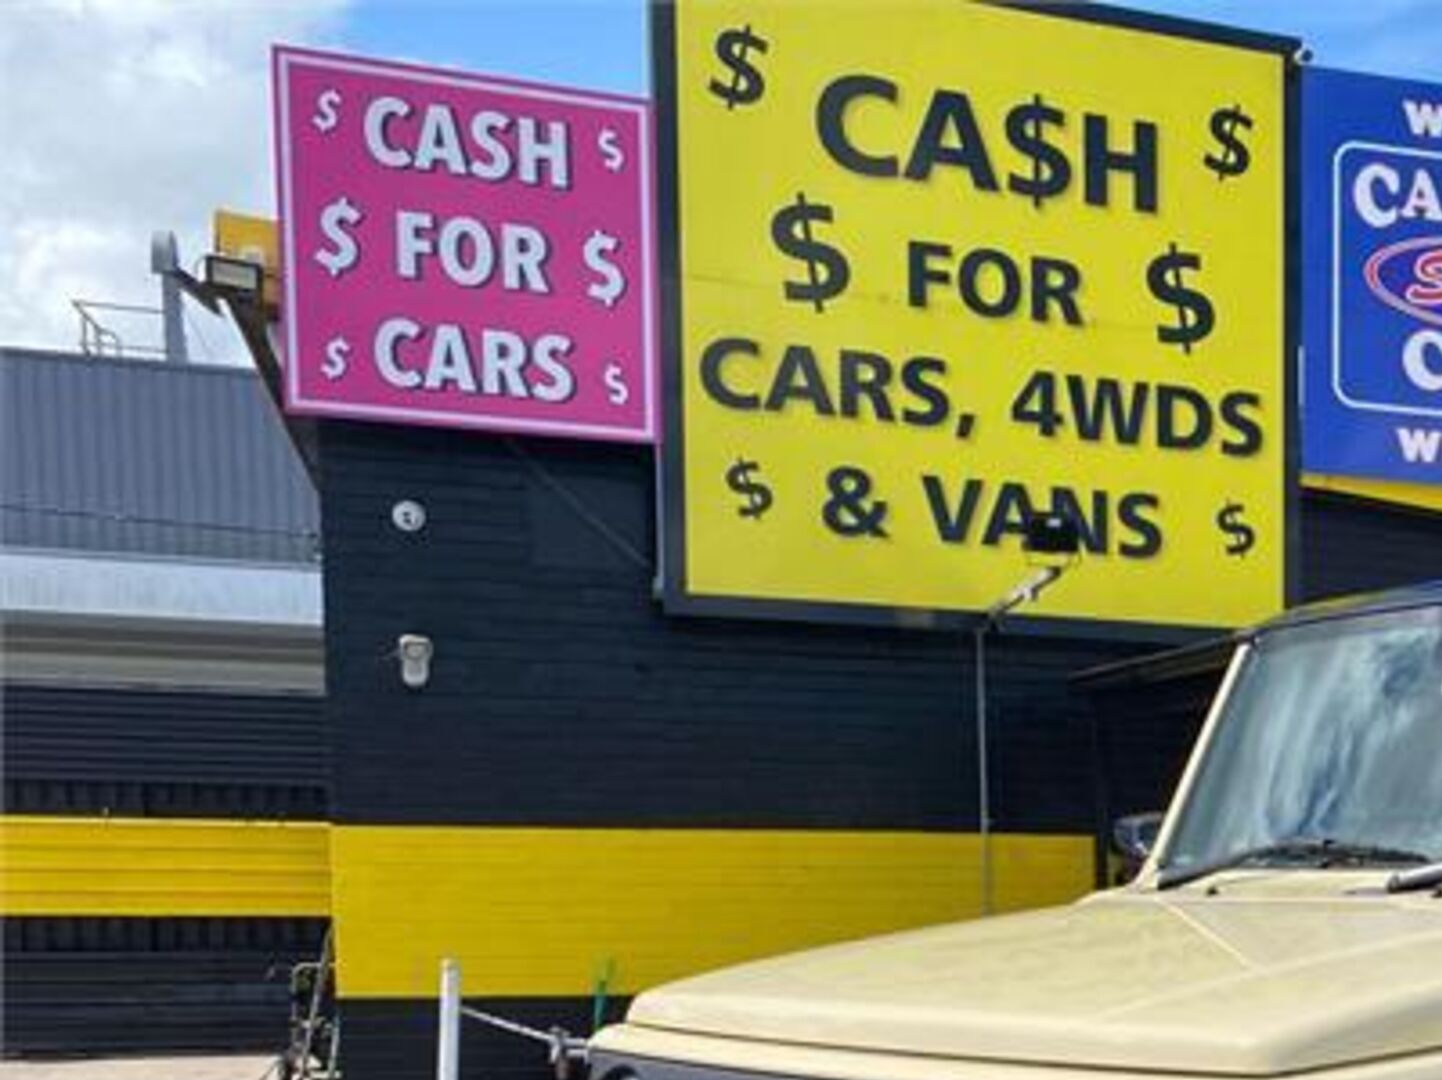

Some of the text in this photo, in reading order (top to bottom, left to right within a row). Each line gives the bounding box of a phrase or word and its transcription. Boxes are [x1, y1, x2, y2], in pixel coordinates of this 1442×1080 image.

[363, 96, 571, 190] CASH
[815, 74, 1158, 214] CA$H
[396, 210, 550, 293] FOR
[906, 239, 1085, 329] FOR
[373, 317, 576, 402] CARS
[699, 336, 1264, 459] CARS, 4WDS
[821, 465, 890, 541] &
[921, 473, 1164, 561] VANS
